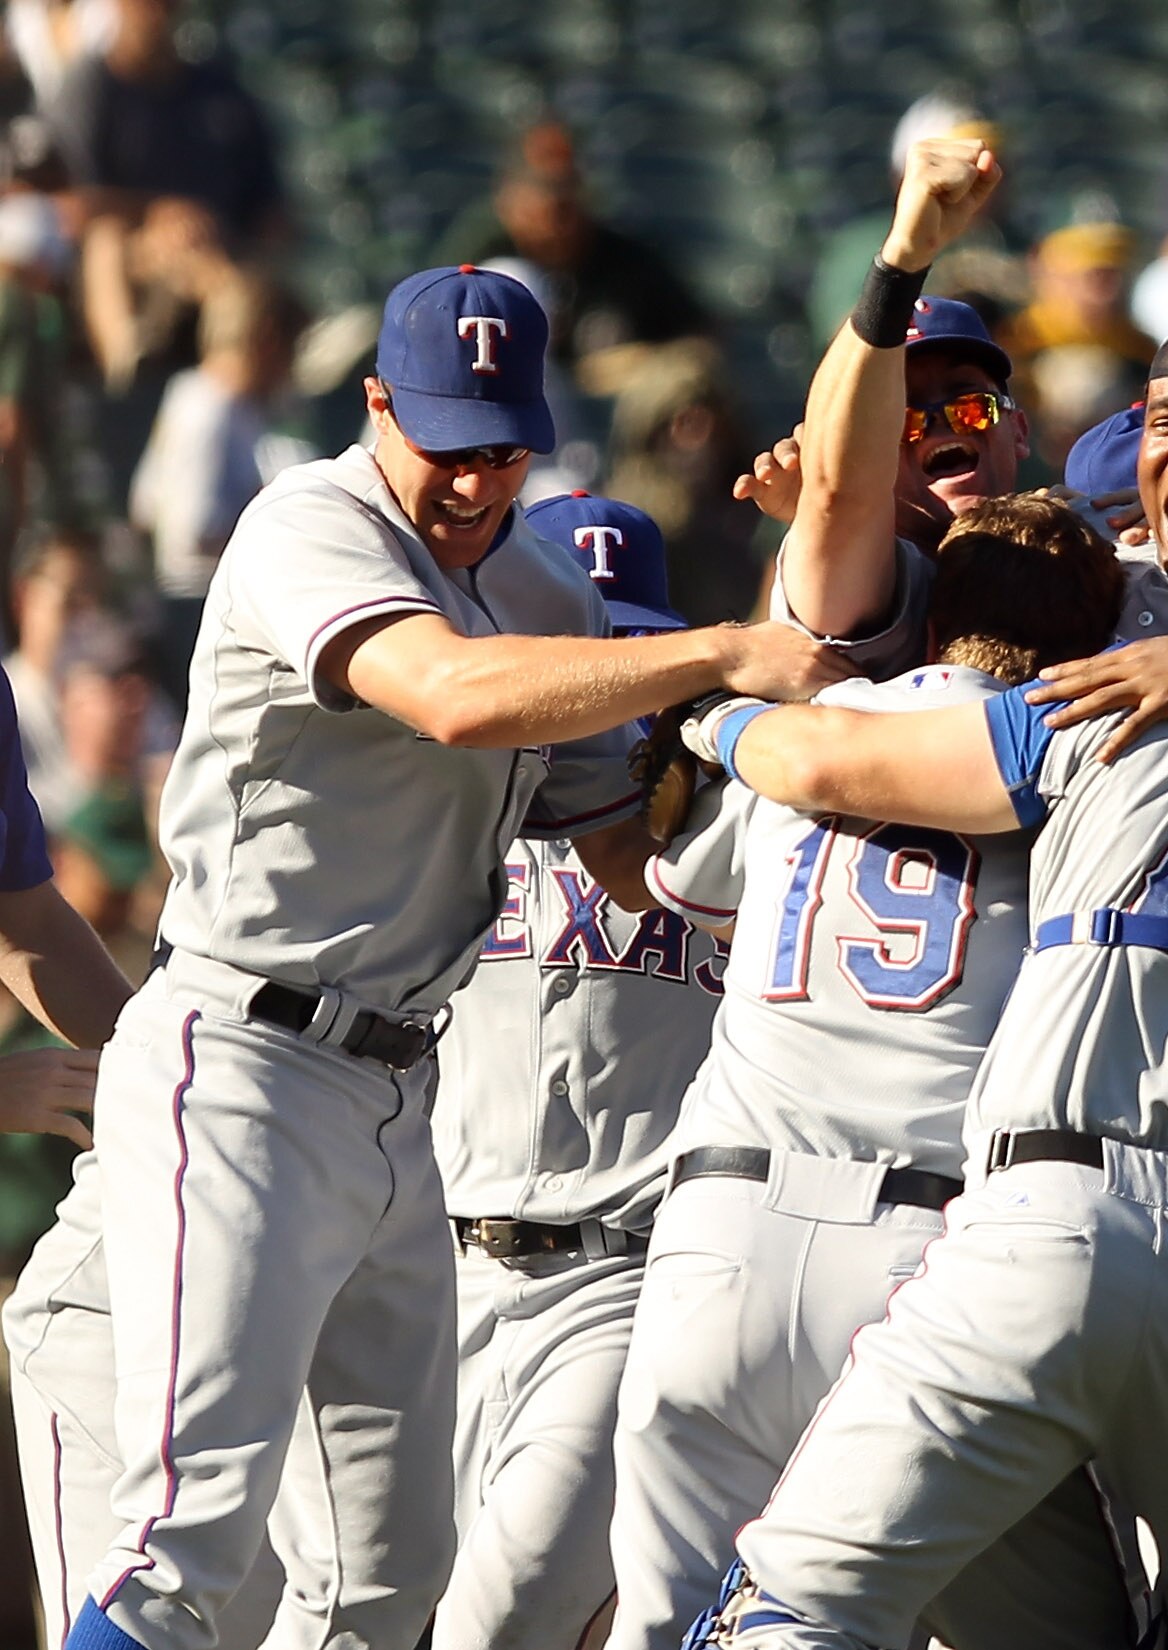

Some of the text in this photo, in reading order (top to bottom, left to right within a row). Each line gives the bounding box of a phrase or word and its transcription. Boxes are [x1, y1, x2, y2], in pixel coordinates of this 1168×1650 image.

[456, 316, 511, 376] T
[572, 525, 627, 583] T
[760, 814, 982, 1013] 19
